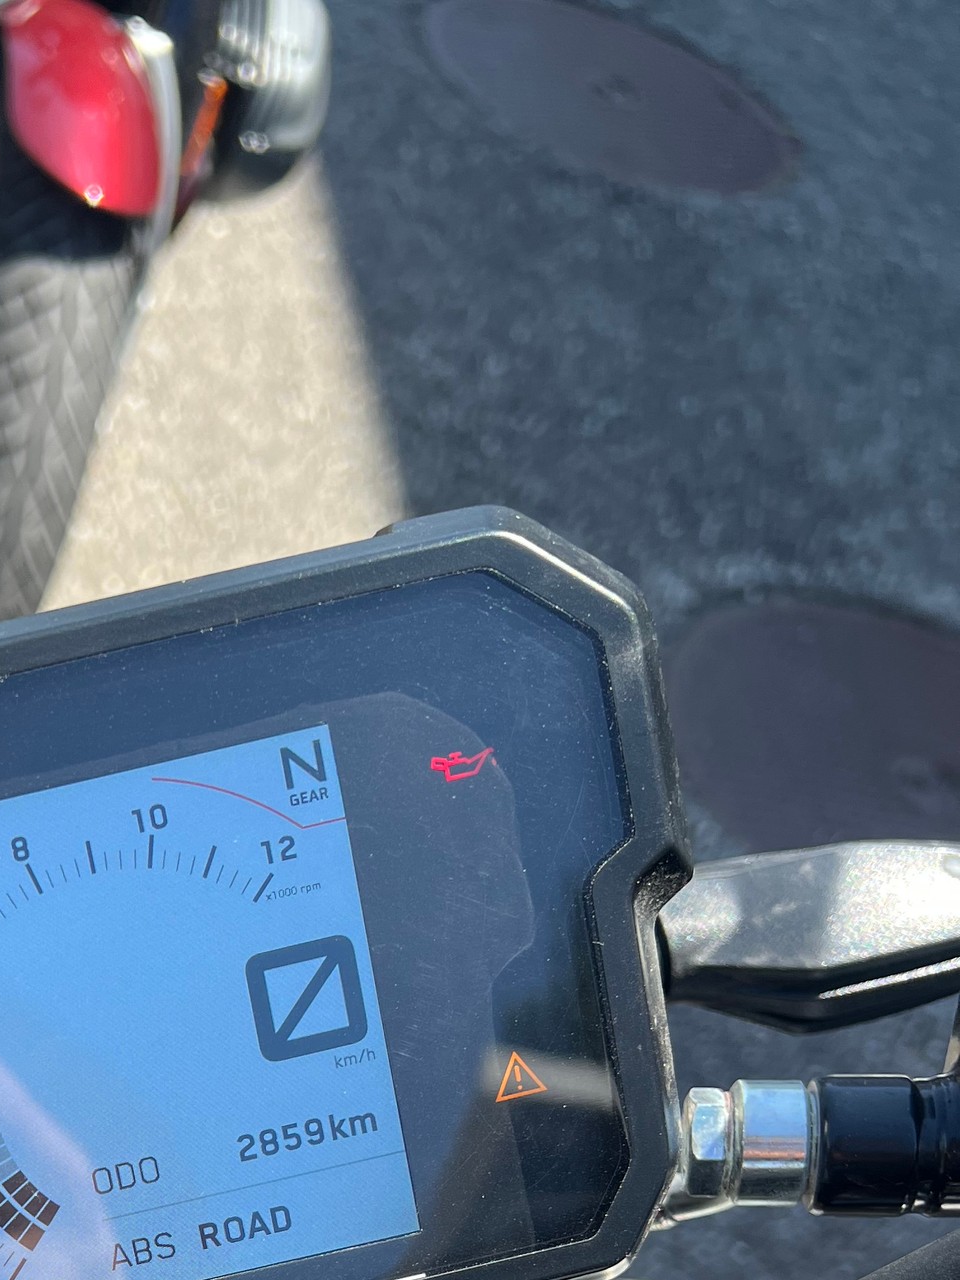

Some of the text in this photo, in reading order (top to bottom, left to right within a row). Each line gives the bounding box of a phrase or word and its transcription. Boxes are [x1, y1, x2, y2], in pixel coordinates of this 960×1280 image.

[279, 739, 328, 790] N
[289, 786, 329, 807] GEAR
[131, 803, 168, 832] 10
[10, 836, 30, 862] 8
[261, 835, 298, 864] 12
[300, 882, 322, 894] rpm
[334, 1047, 377, 1069] km/h
[237, 1111, 378, 1163] 2859km
[91, 1156, 161, 1195] ODO
[111, 1205, 292, 1271] ABS ROAD
